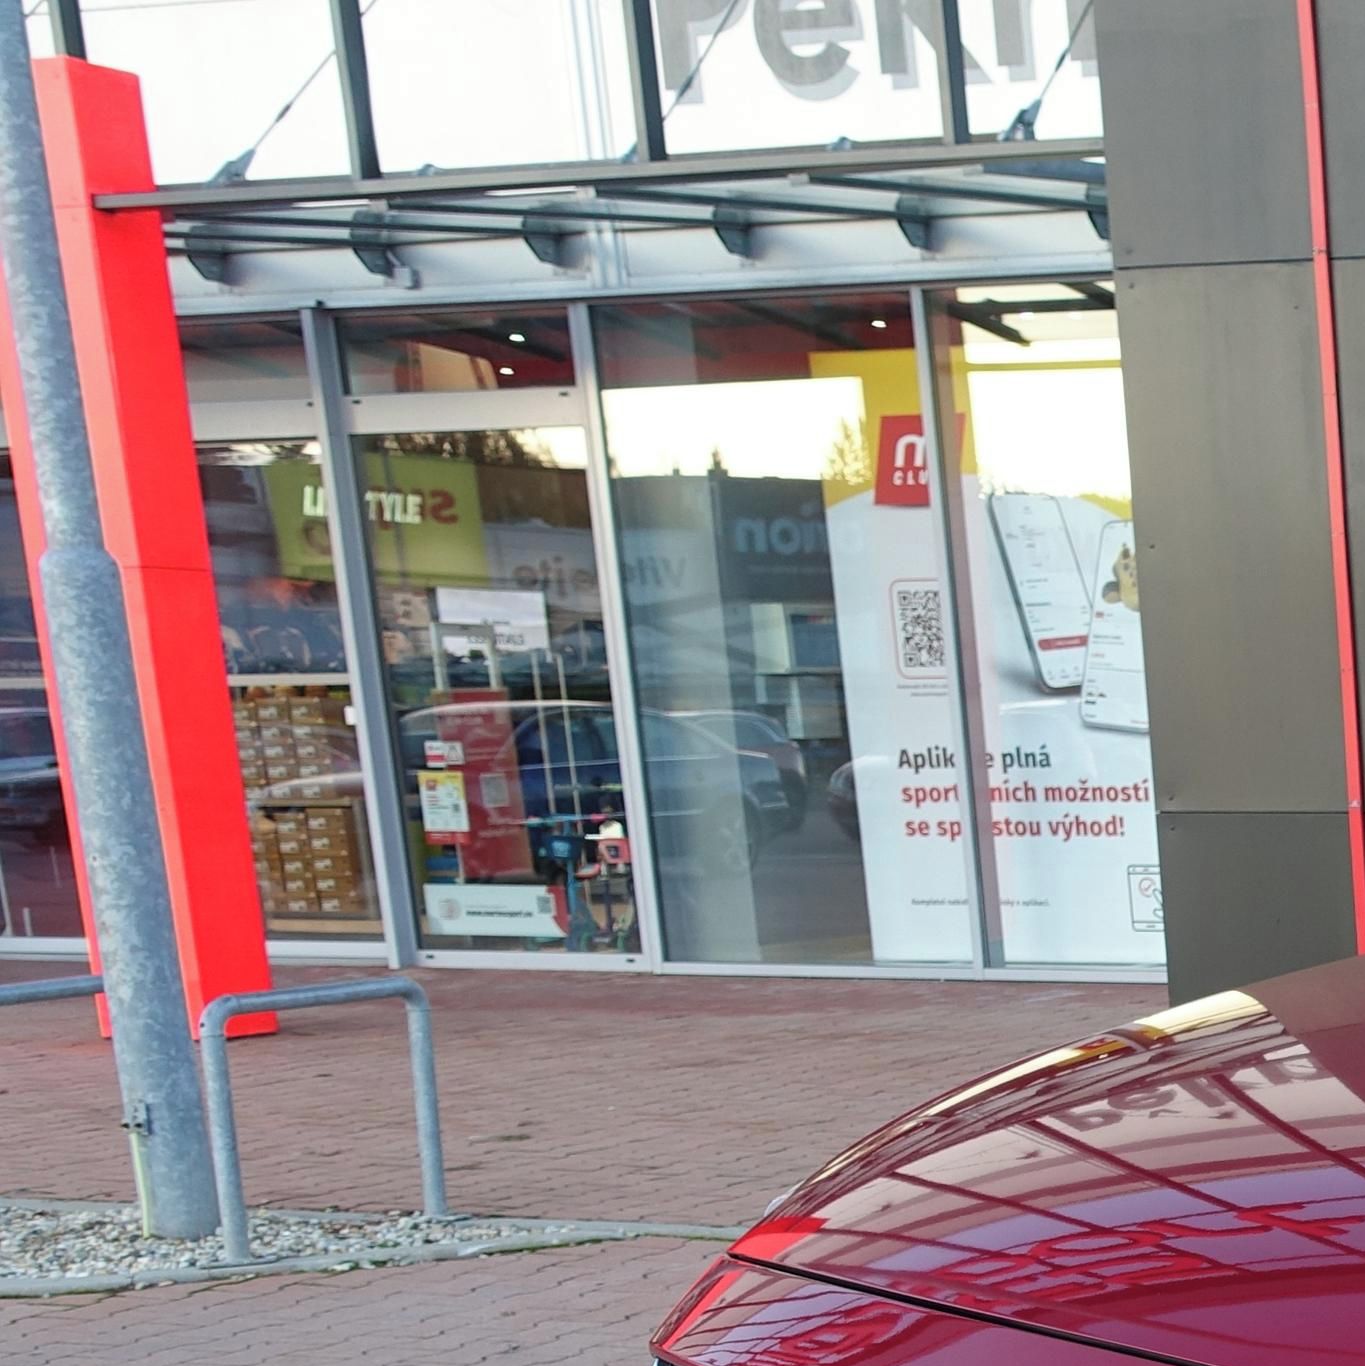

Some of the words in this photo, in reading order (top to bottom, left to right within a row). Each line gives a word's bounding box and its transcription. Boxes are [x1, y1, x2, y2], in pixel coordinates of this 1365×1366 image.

[892, 470, 929, 486] CLU
[303, 484, 424, 525] LITYLE
[898, 746, 995, 775] Aplike
[1002, 744, 1052, 774] plná
[901, 780, 1037, 808] sportních
[1044, 778, 1150, 803] možností
[905, 820, 930, 837] se
[937, 818, 1042, 842] spstou
[1047, 814, 1125, 842] výhod!
